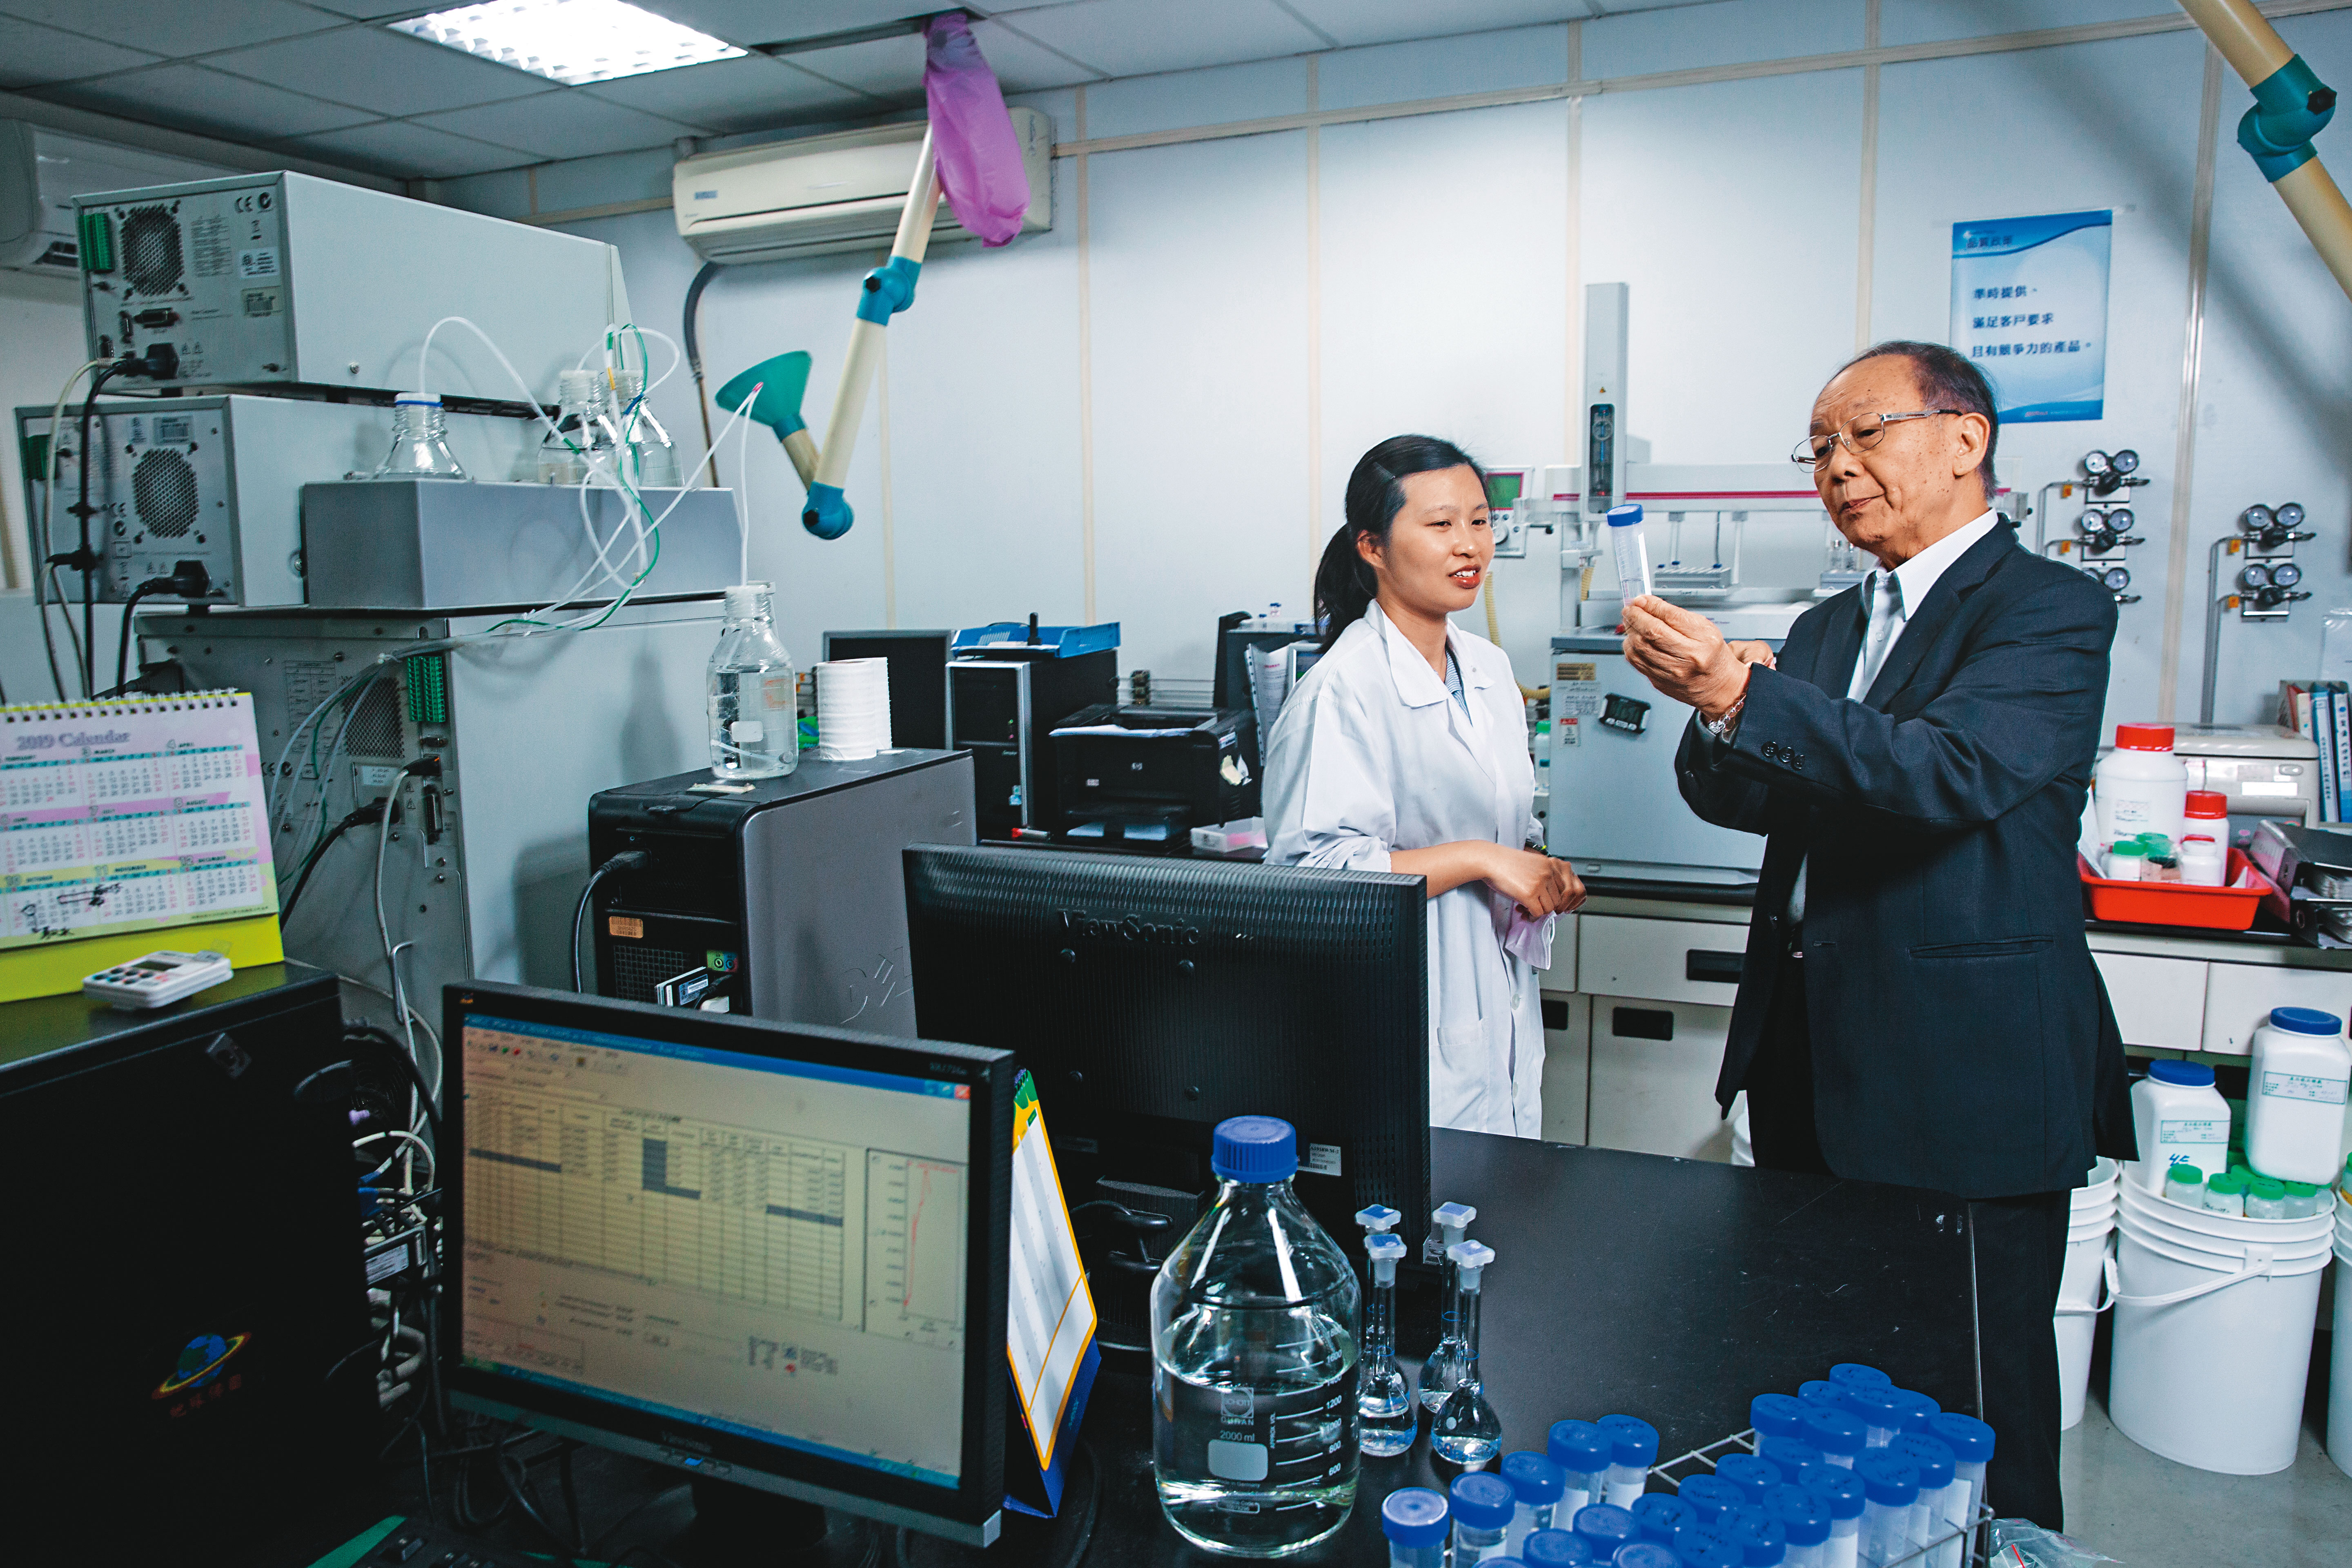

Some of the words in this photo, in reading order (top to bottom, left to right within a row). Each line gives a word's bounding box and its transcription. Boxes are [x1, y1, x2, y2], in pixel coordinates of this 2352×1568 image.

[17, 733, 54, 751] 2019
[58, 729, 130, 747] Calendar
[1057, 908, 1200, 944] ViewSonic
[1326, 1395, 1342, 1410] 1200
[1220, 1430, 1243, 1441] 2000
[1244, 1433, 1255, 1442] ml
[1329, 1440, 1341, 1454] 800
[1329, 1463, 1341, 1477] 600
